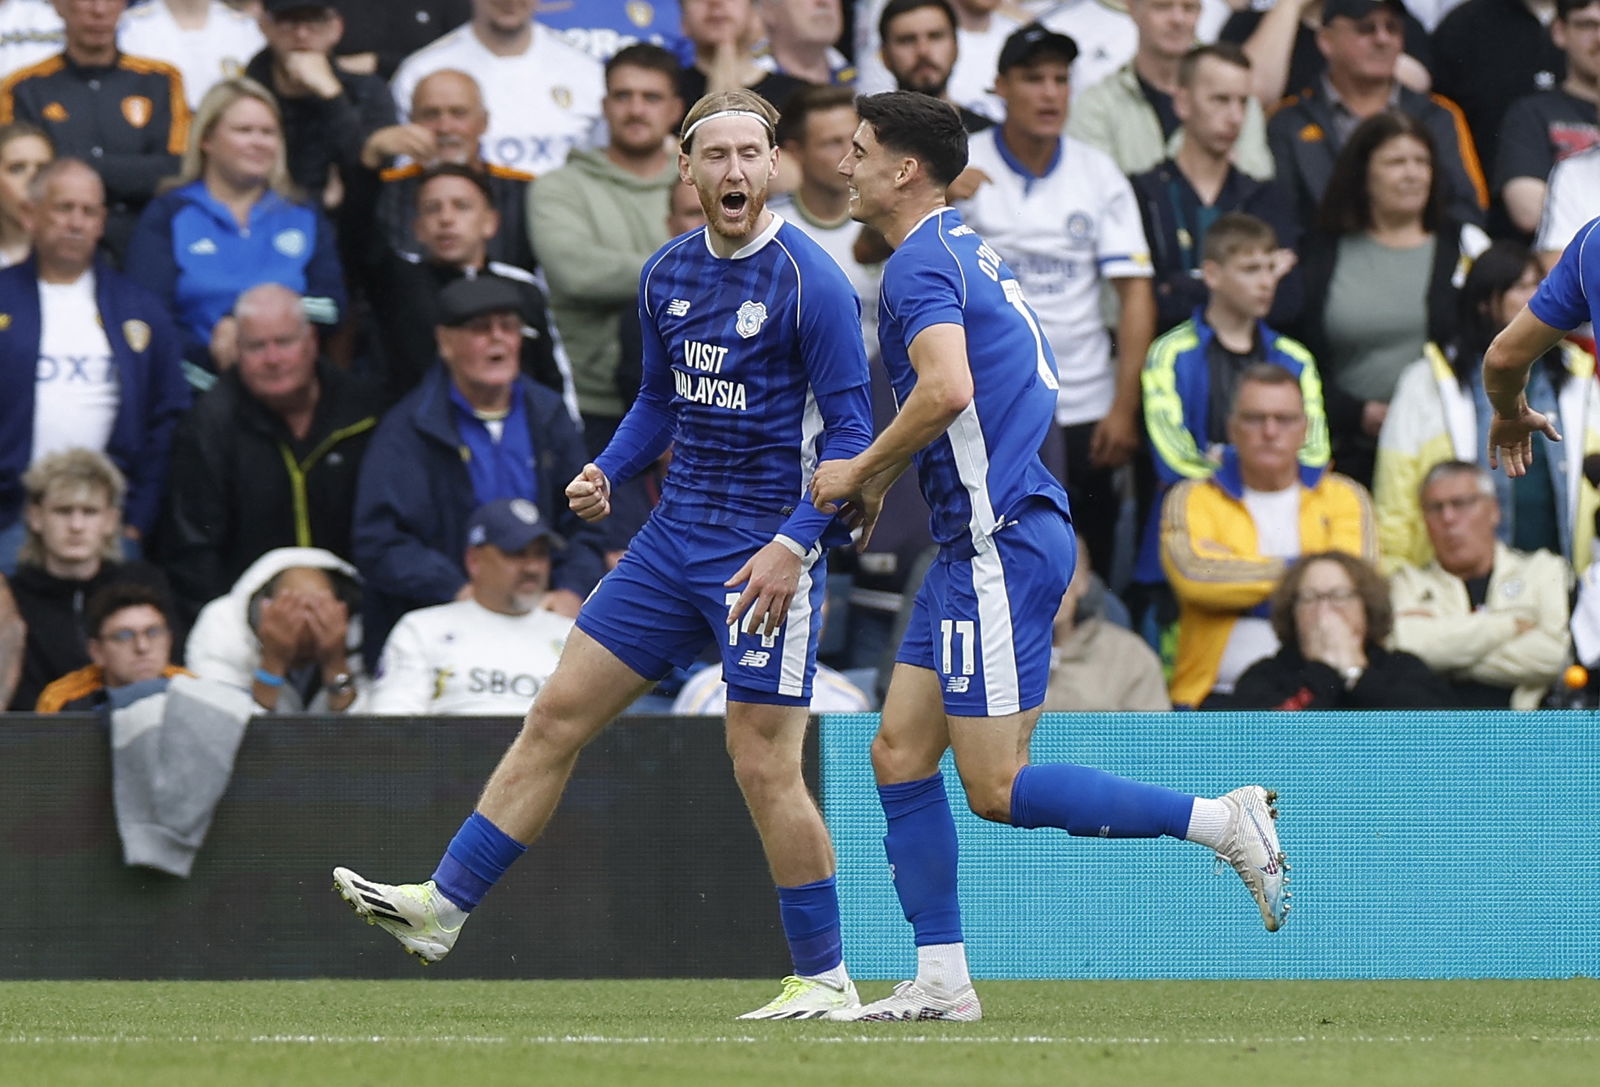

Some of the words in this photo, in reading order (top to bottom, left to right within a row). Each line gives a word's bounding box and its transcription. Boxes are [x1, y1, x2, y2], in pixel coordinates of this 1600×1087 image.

[684, 339, 729, 374] VISIT
[940, 619, 975, 675] 11
[468, 667, 548, 698] SBO
